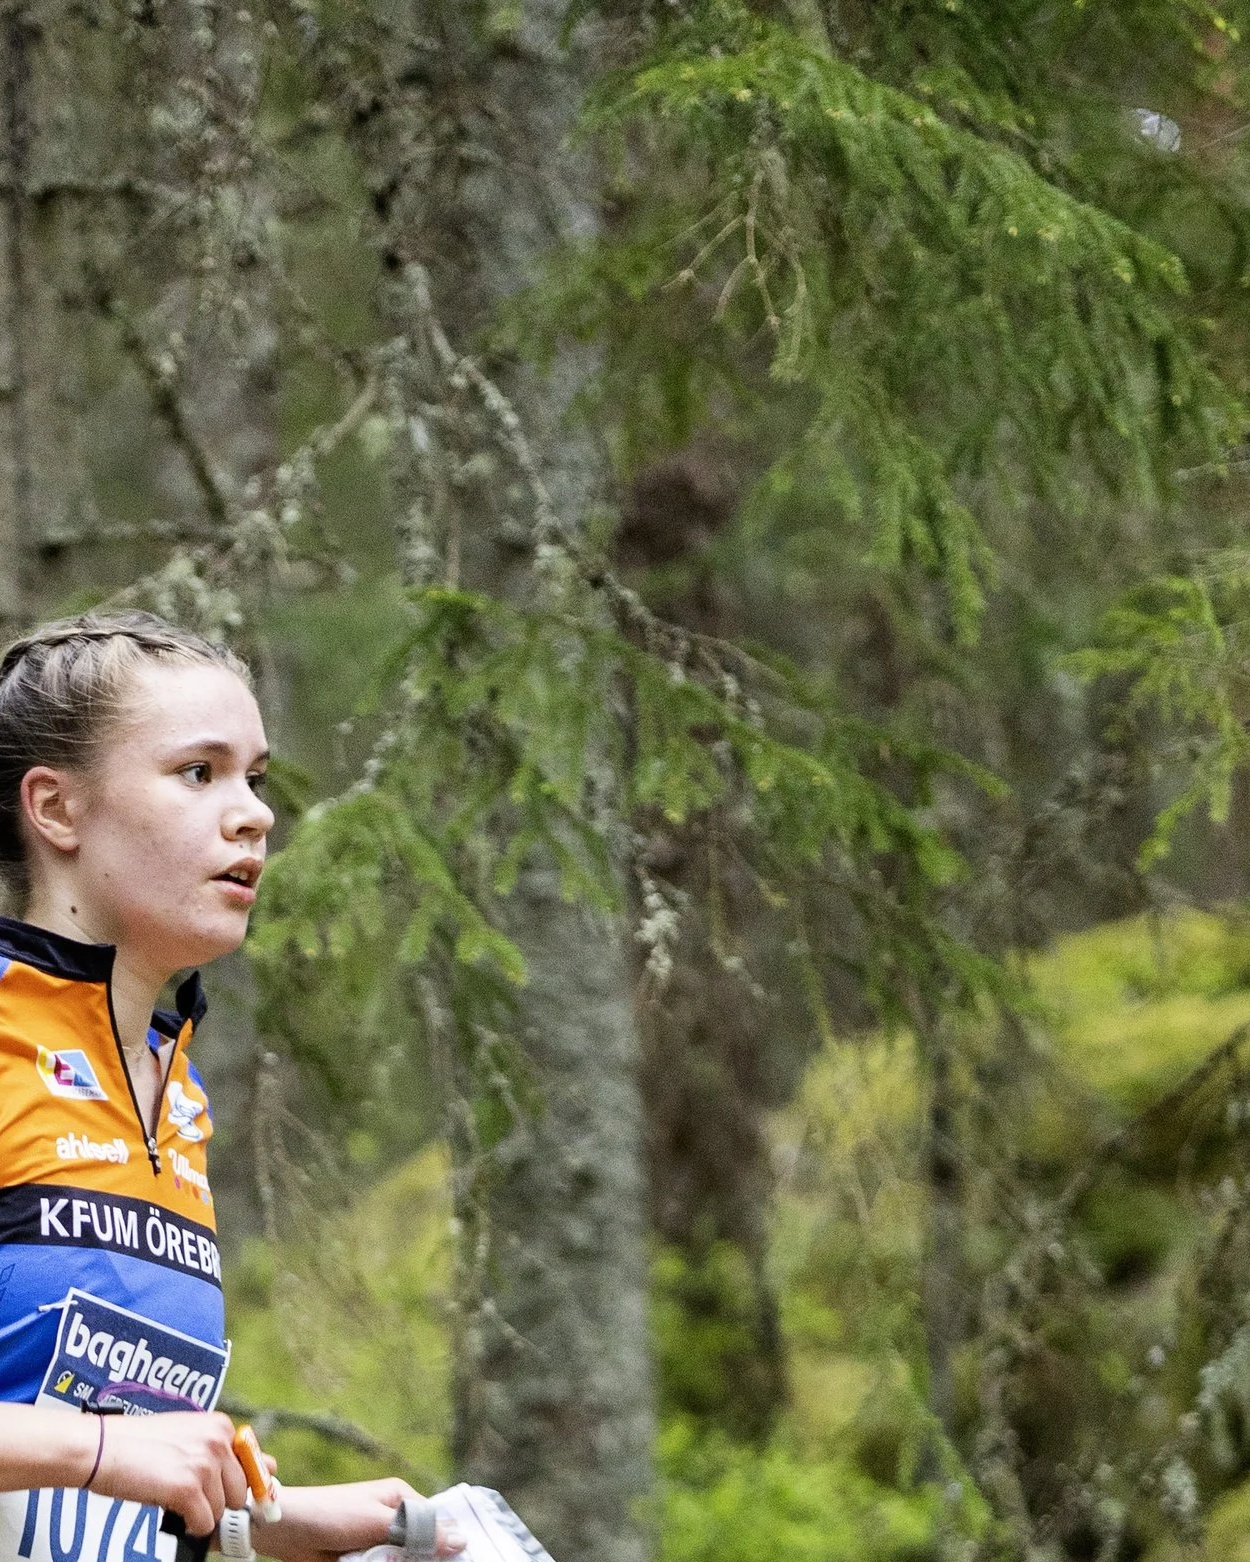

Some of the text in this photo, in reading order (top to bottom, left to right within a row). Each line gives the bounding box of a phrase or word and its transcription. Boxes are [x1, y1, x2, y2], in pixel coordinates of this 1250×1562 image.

[56, 1132, 129, 1165] ahlsell
[40, 1198, 139, 1249] KFUM
[65, 1312, 216, 1408] bagheera
[73, 1382, 94, 1402] SM
